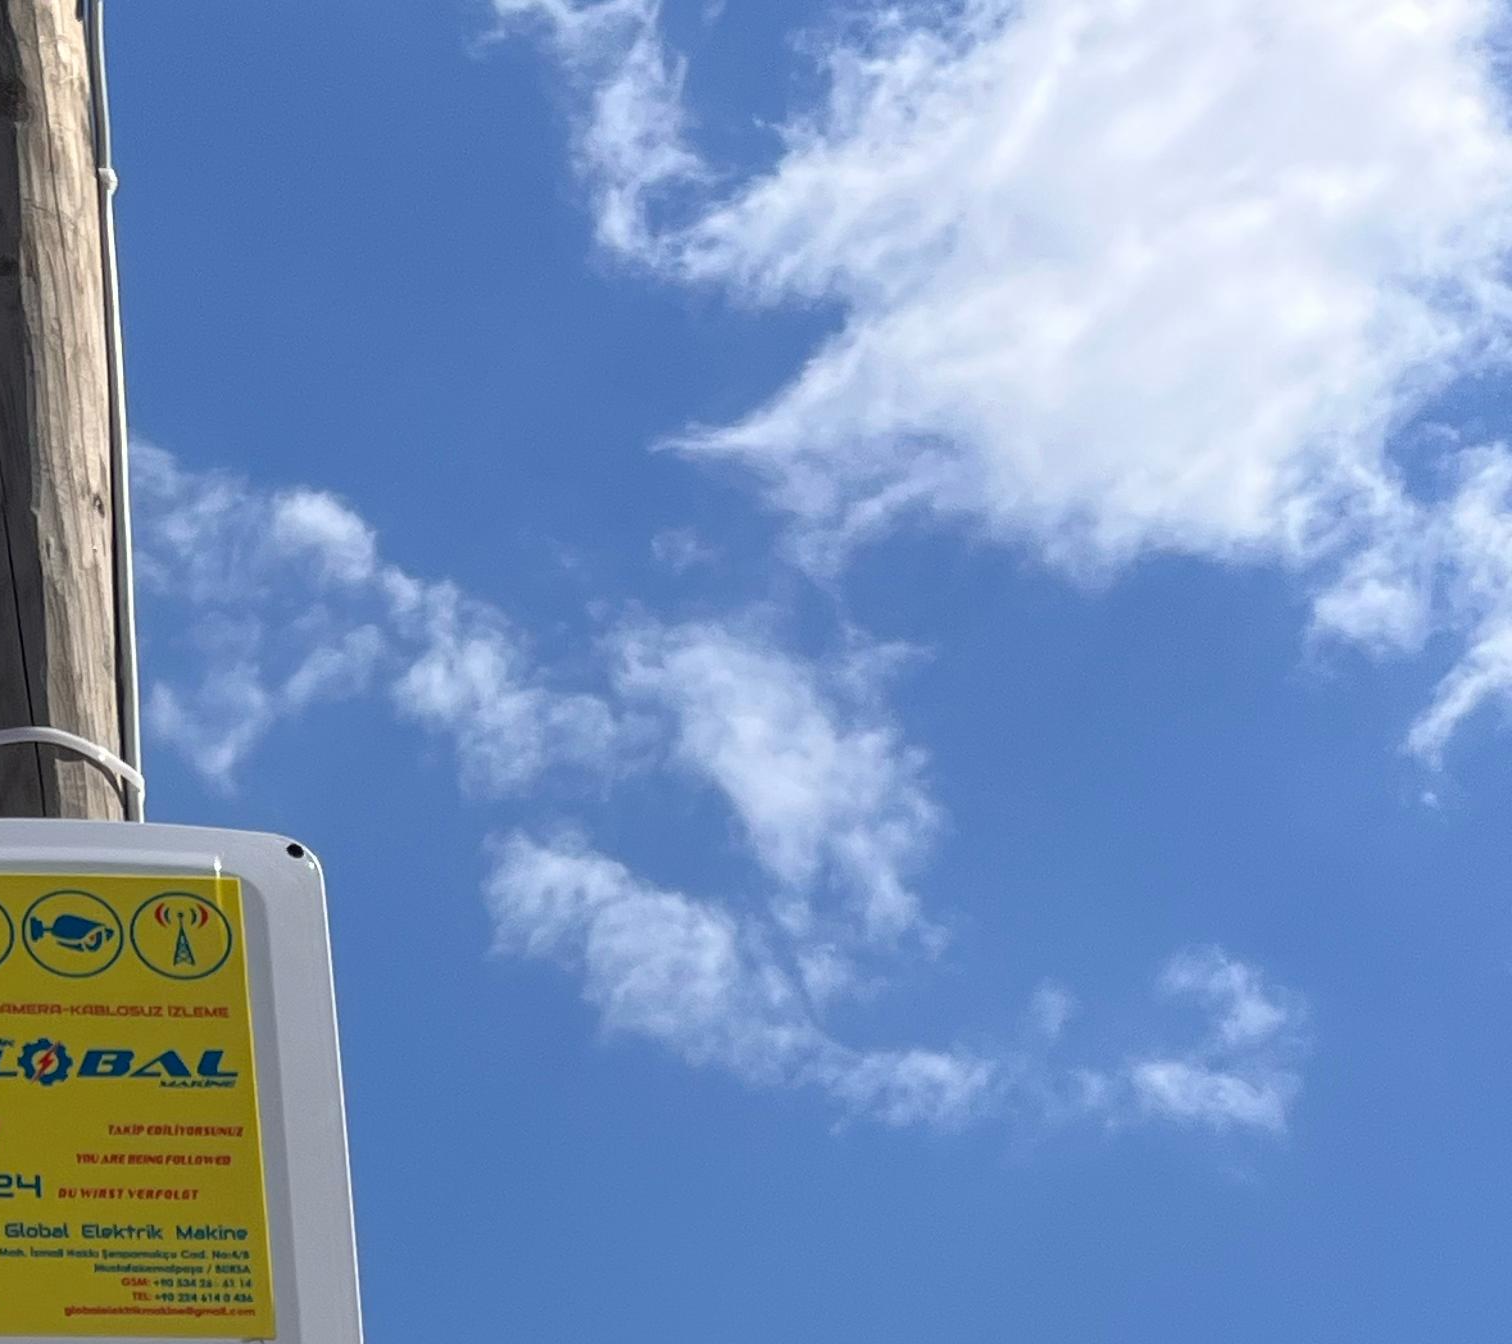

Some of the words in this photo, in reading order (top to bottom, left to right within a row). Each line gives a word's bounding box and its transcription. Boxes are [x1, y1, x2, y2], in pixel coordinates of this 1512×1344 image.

[76, 1153, 99, 1165] YOU
[101, 1154, 125, 1165] ARE
[128, 1154, 163, 1166] BEING
[165, 1155, 232, 1166] FOLLOWED
[58, 1188, 76, 1199] DU
[81, 1188, 124, 1199] WIRST
[4, 1222, 69, 1239] Global
[81, 1224, 163, 1240] Elektrik
[176, 1225, 248, 1240] Makine
